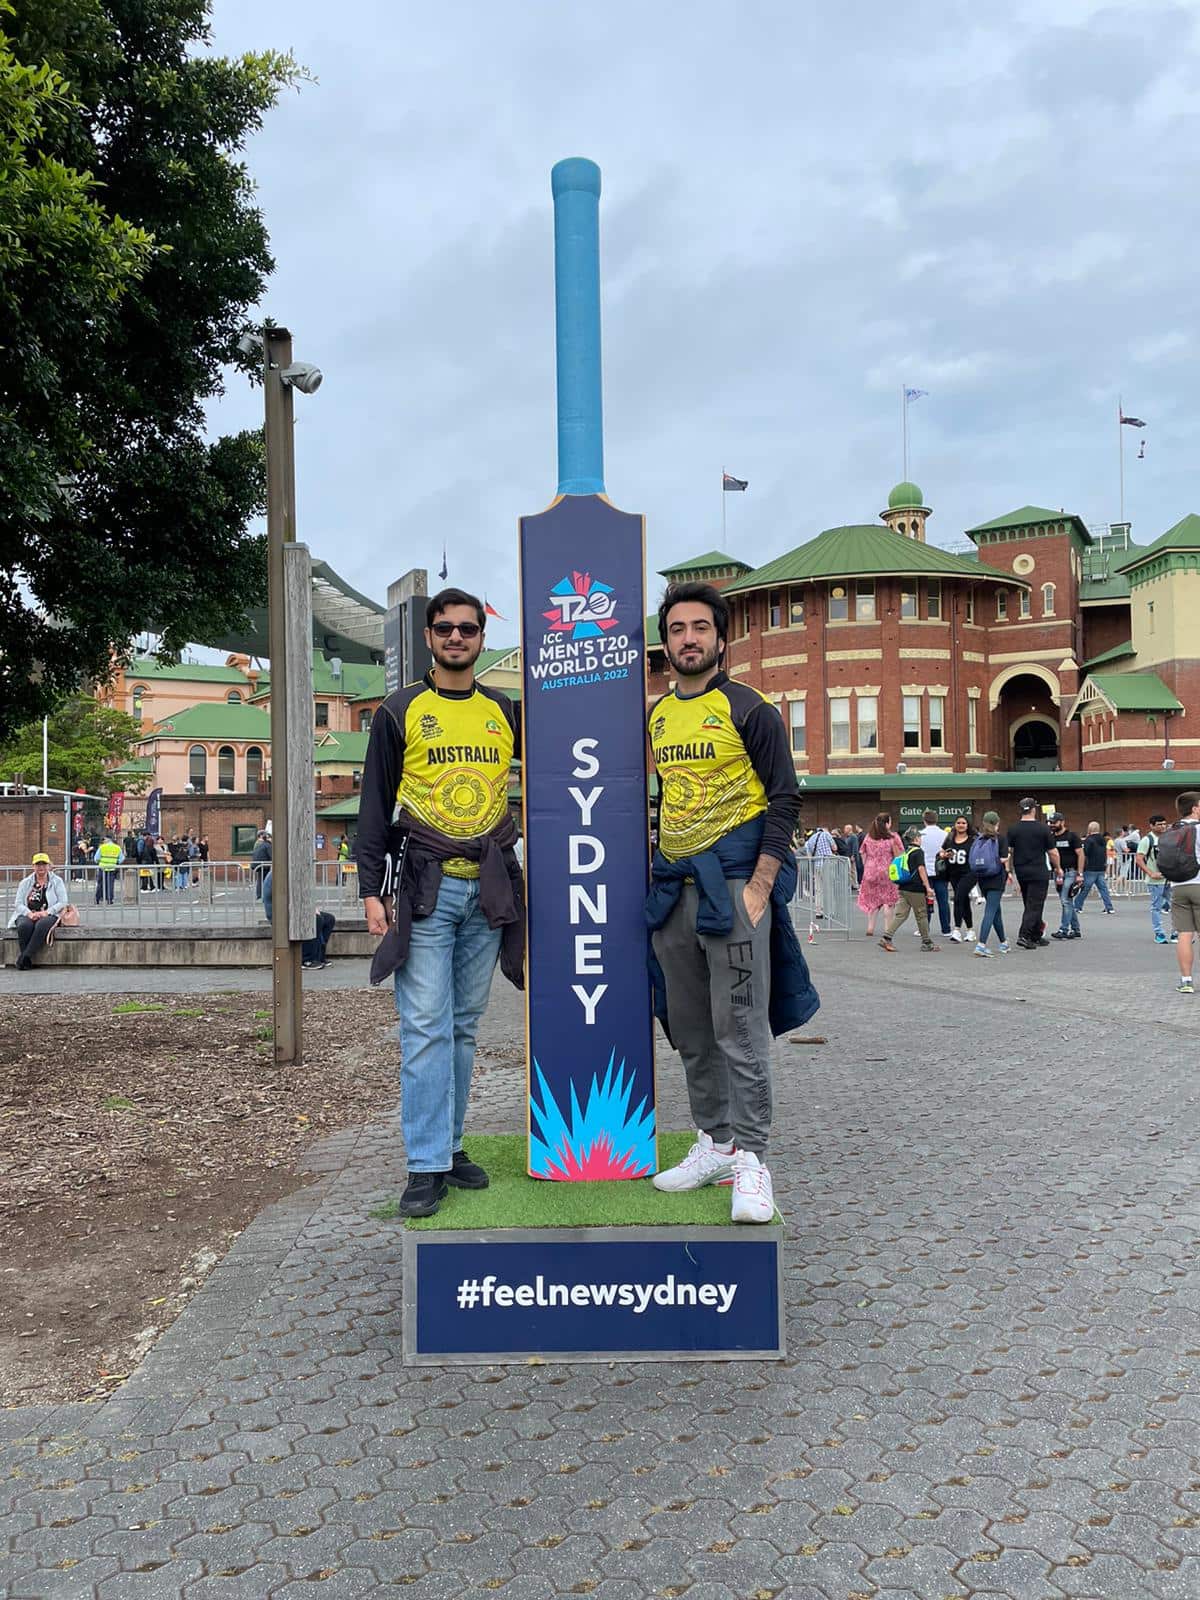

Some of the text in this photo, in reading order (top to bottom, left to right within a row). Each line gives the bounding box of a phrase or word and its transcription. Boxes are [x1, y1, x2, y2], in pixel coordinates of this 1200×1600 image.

[539, 635, 628, 662] MEN'S T20
[543, 632, 563, 645] ICC
[531, 649, 638, 679] WORLD CUP
[541, 668, 629, 690] AUSTRALIA 2022
[427, 745, 500, 765] AUSTRALIA
[655, 742, 716, 764] USTRALIA
[900, 806, 922, 816] Gate
[939, 806, 965, 816] Entry
[966, 806, 972, 815] 2
[568, 738, 608, 1025] SYDNEY
[726, 940, 754, 1009] EA7
[456, 1274, 738, 1314] #feelnewsydney
